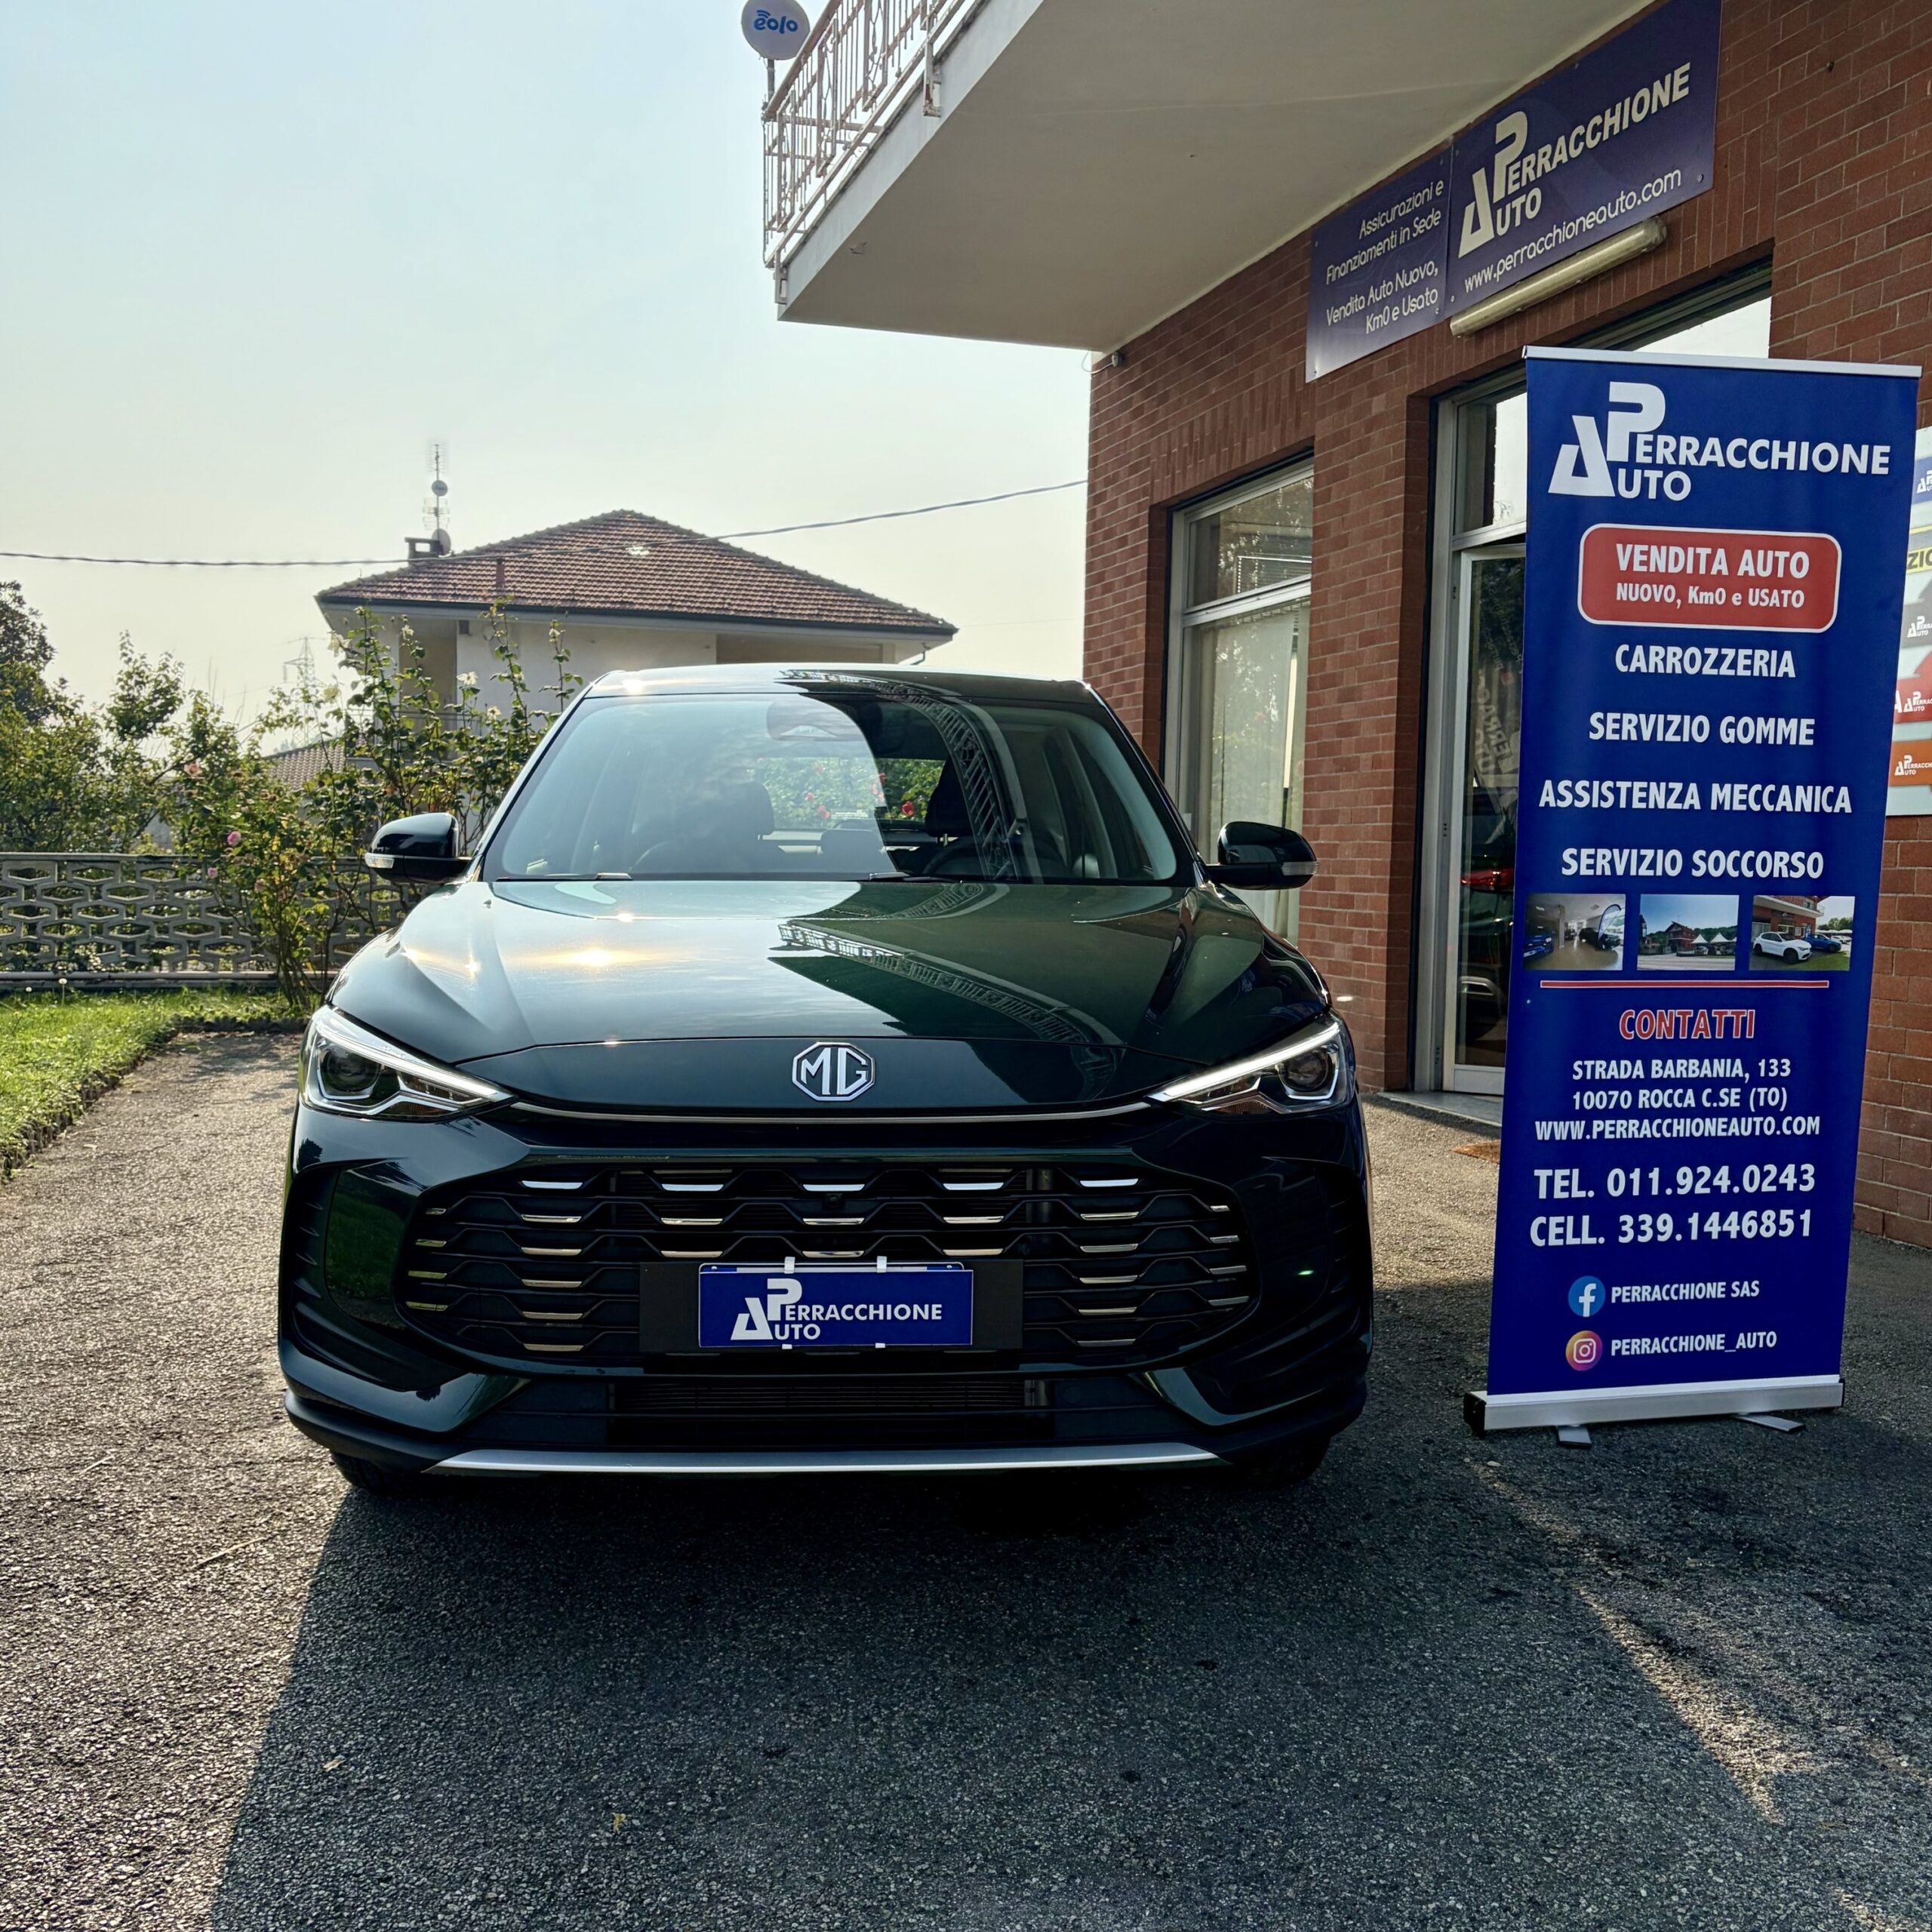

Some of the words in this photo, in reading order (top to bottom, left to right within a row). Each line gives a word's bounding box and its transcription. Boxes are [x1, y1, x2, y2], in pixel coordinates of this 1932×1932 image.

[753, 14, 798, 35] eolo
[1493, 63, 1690, 204] PERRACCHIONE
[1359, 182, 1433, 240] Assicurazioni
[1435, 180, 1444, 196] e
[1458, 167, 1543, 258] AUTO
[1326, 229, 1398, 285] Finanziamenti
[1399, 226, 1411, 245] in
[1413, 208, 1441, 238] Sede
[1464, 168, 1682, 294] www.perracchioneauto.com
[1326, 294, 1366, 327] Vendita
[1367, 279, 1394, 306] Auto
[1395, 260, 1438, 292] Nuovo,
[1366, 305, 1390, 334] Km0
[1392, 306, 1400, 321] e
[1402, 288, 1438, 317] Usato
[1606, 381, 1891, 475] PERRACCHIONE
[1548, 414, 1692, 502] AUTO
[1616, 543, 1729, 576] VENDITA
[1737, 549, 1810, 580] AUTO
[1616, 582, 1682, 610] NUOVO,
[1687, 585, 1727, 605] Km0
[1731, 592, 1743, 606] e
[1748, 588, 1805, 608] USATO
[1615, 644, 1796, 678] CARROZZERIA
[1589, 712, 1710, 743] SERVIZIO
[1719, 715, 1815, 746] GOMME
[1539, 780, 1701, 810] ASSISTENZA
[1710, 783, 1852, 814] MECCANICA
[1561, 848, 1683, 877] SERVIZIO
[1691, 849, 1824, 879] SOCCORSO
[1619, 1009, 1755, 1039] CONTATTI
[800, 1046, 869, 1096] MG
[1572, 1060, 1644, 1080] STRADA
[1651, 1058, 1749, 1084] BARBANIA,
[1758, 1058, 1791, 1077] 133
[1573, 1090, 1632, 1110] 10070
[1638, 1088, 1696, 1109] ROCCA
[1702, 1088, 1741, 1107] C.SE
[1749, 1087, 1787, 1112] (TO)
[1534, 1115, 1820, 1140] WWW.PERRACCHIONEAUTO.COM
[1534, 1168, 1595, 1199] TEL.
[1607, 1163, 1815, 1197] 011.924.0243
[1530, 1215, 1605, 1247] CELL.
[1618, 1209, 1810, 1244] 339.1446851
[766, 1278, 943, 1321] PERRACCHIONE
[1611, 1281, 1727, 1303] PERRACCHIONE
[1730, 1280, 1760, 1297] SAS
[730, 1297, 821, 1341] AUTO
[1611, 1331, 1777, 1356] PERRACCHIONE_AUTO
